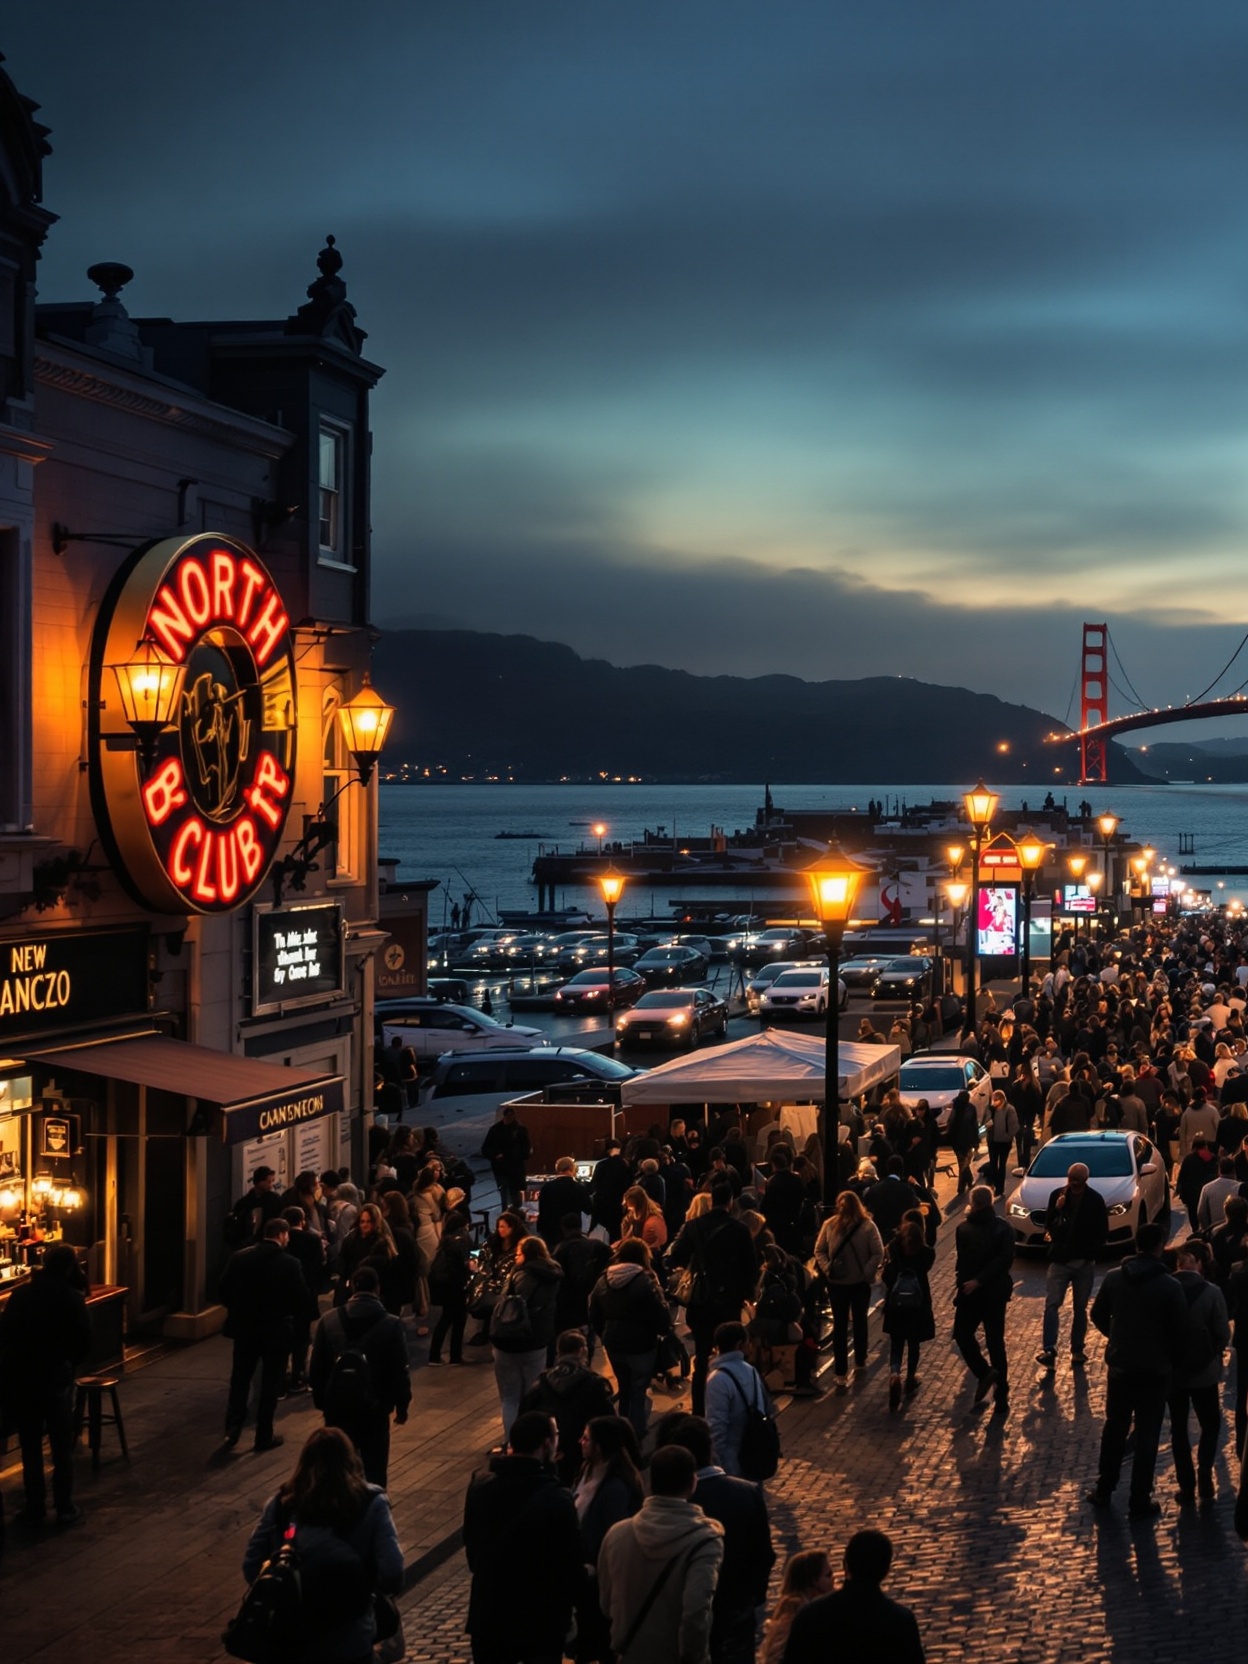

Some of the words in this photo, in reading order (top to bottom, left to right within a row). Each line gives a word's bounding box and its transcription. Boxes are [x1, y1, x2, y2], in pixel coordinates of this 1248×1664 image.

[149, 552, 288, 664] NORTH
[170, 817, 262, 901] CLUB
[11, 944, 47, 973] NEW
